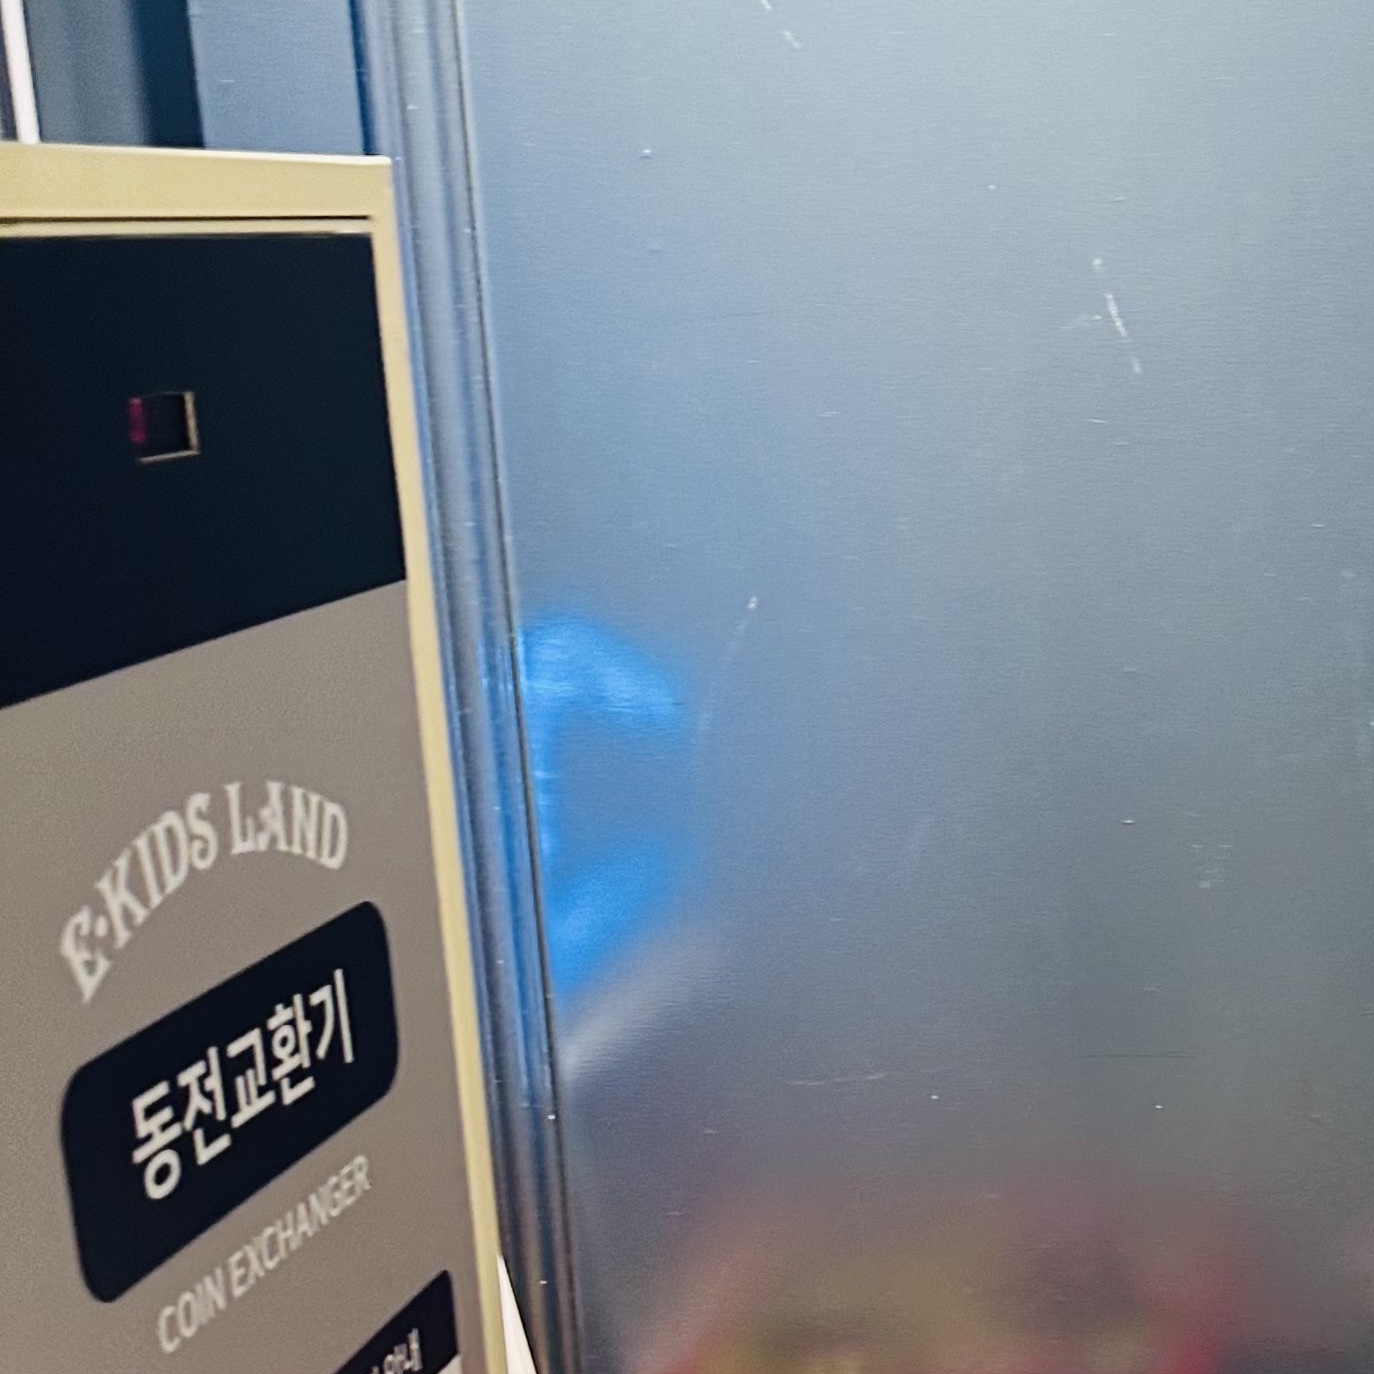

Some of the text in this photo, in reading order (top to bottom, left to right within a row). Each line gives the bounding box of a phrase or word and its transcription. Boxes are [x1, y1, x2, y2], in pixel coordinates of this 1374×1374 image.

[223, 780, 349, 869] LAND
[131, 968, 355, 1200] 동전교환기
[158, 1155, 371, 1354] COIN EXCHANGER
